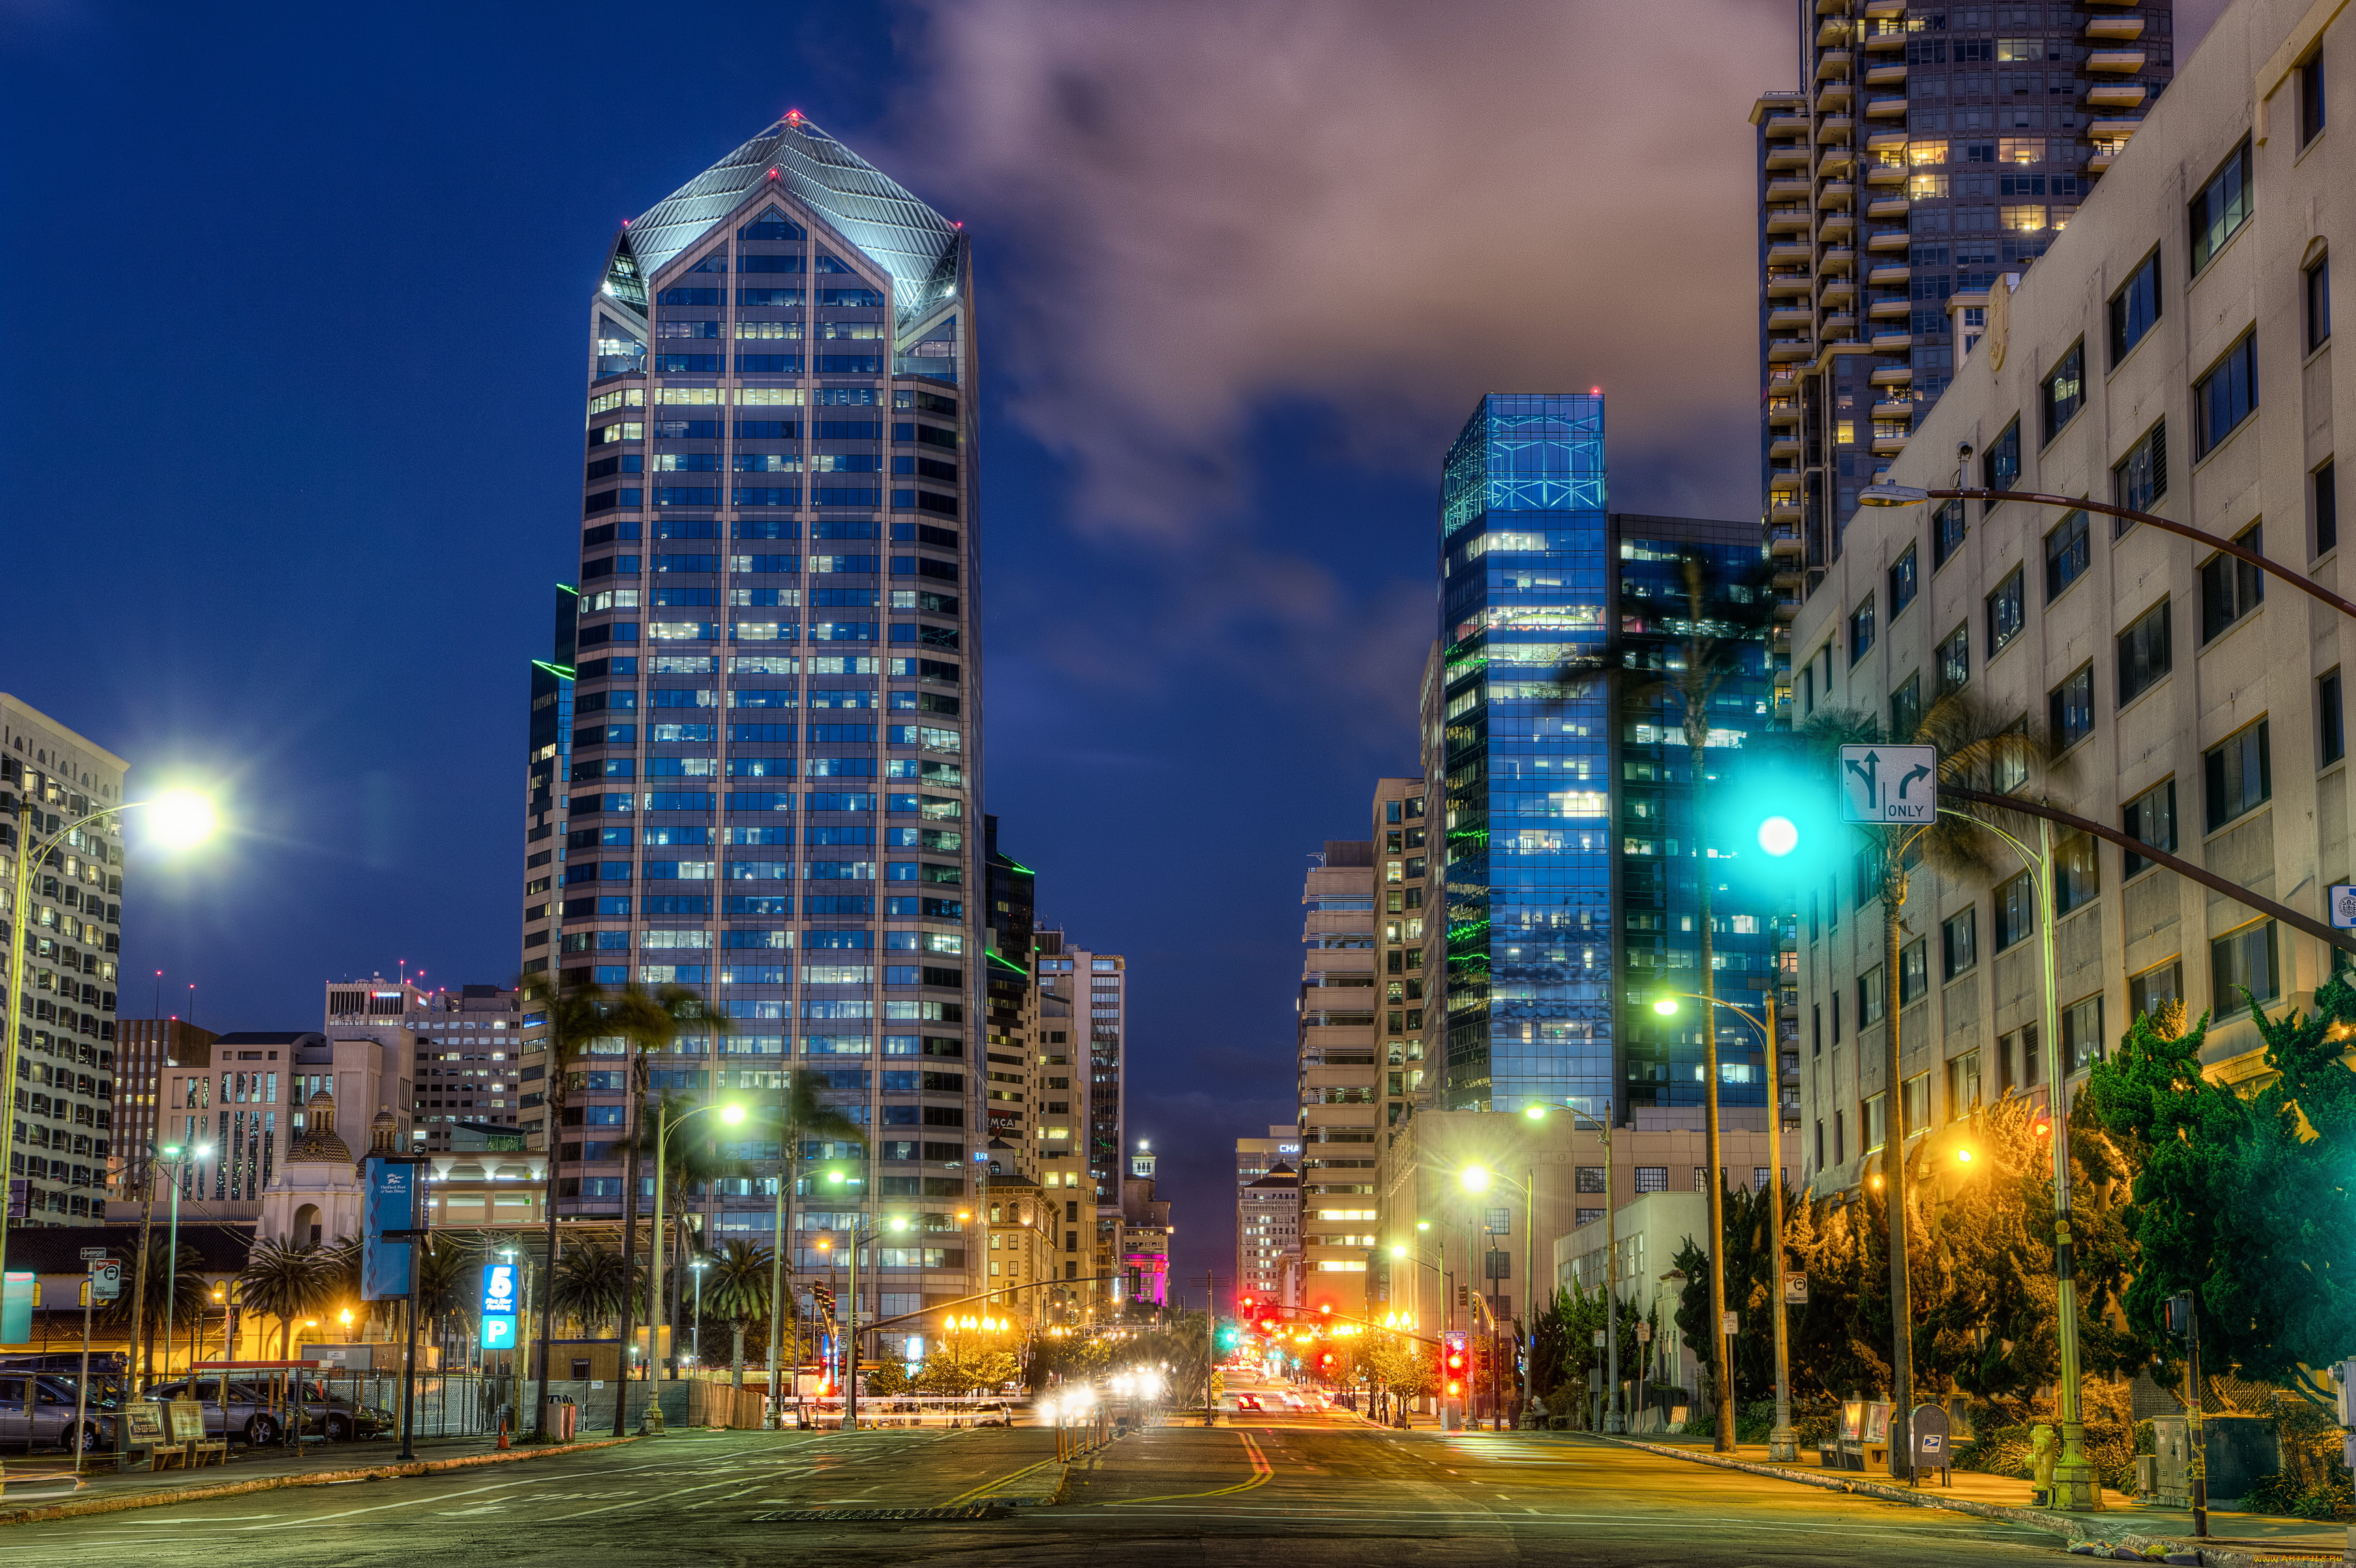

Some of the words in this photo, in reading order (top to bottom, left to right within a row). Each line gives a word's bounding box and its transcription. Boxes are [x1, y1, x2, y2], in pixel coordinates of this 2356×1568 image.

[1888, 804, 1924, 817] ONLY
[988, 1118, 1014, 1127] MCA
[488, 1267, 512, 1298] 5
[487, 1320, 508, 1343] P
